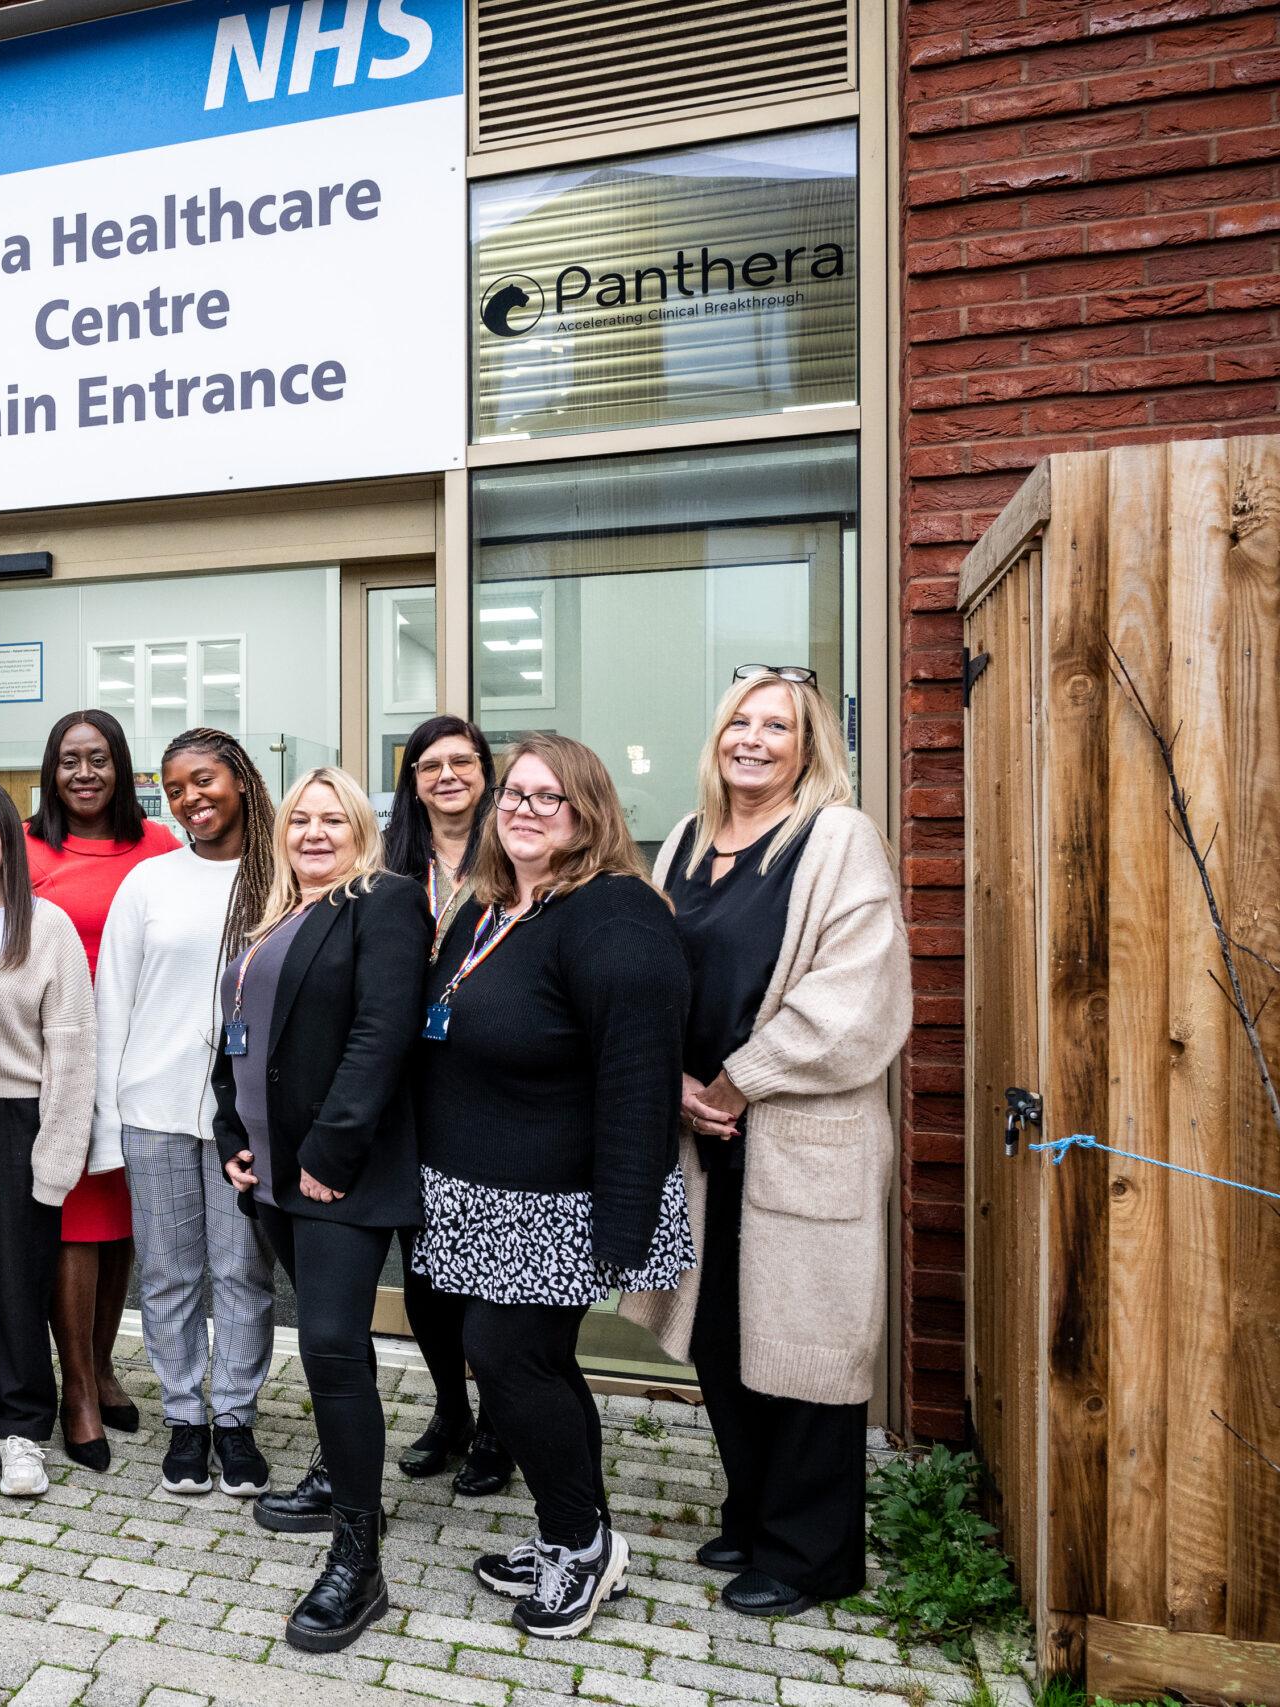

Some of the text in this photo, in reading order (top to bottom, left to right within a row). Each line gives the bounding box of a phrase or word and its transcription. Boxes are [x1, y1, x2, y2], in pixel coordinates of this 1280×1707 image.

[204, 0, 432, 111] NHS
[53, 178, 382, 267] Healthcare
[556, 242, 844, 314] Panthera
[557, 291, 805, 332] Accelerating Clinical Breakthrough
[34, 286, 230, 351] Centre
[77, 359, 347, 428] Entrance
